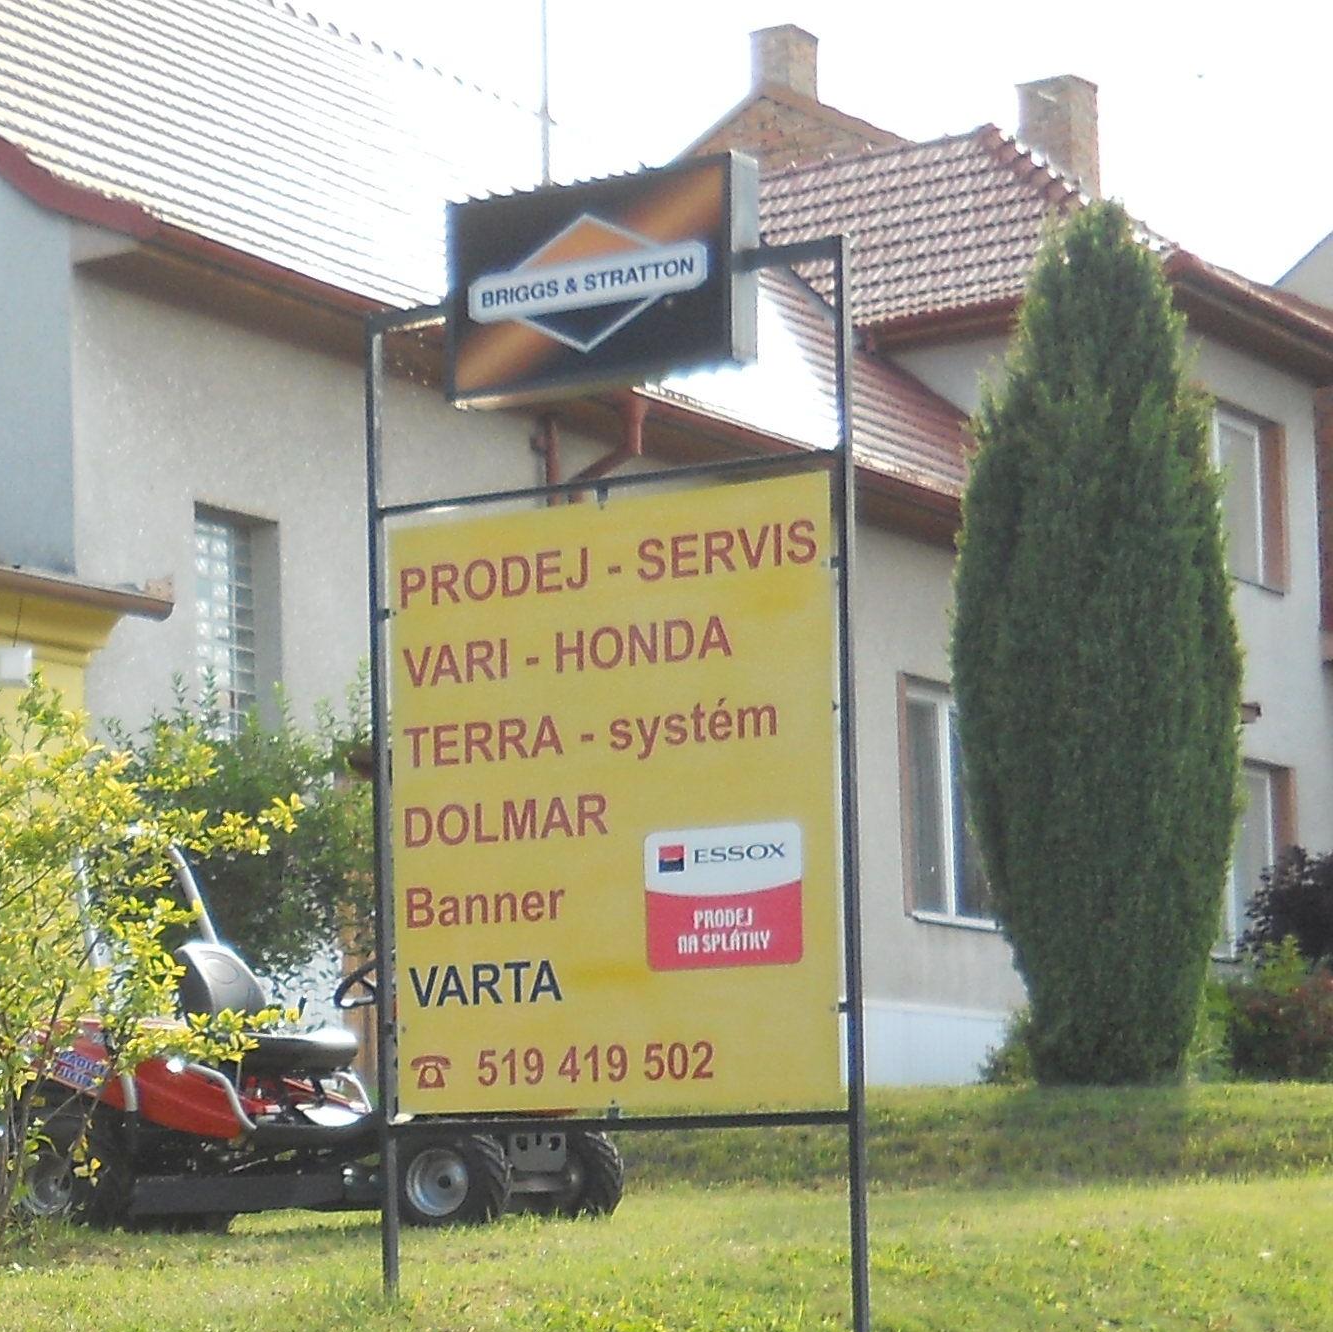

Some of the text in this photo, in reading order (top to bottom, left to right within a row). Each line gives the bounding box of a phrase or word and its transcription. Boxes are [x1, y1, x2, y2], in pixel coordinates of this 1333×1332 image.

[481, 256, 695, 309] BRIGGS & STRATTON
[399, 519, 818, 609] PRODEJ - SERVIS
[402, 615, 732, 687] VARI - HONDA
[403, 698, 778, 768] TERRA - systém
[404, 793, 609, 849] DOLMAR
[694, 842, 785, 864] ESSOX
[405, 886, 565, 929] Banner
[693, 907, 753, 930] PRODEJ
[678, 928, 771, 954] NA SPLÁTKY
[408, 959, 563, 1008] VARTA
[476, 1040, 714, 1086] 519 419 502
